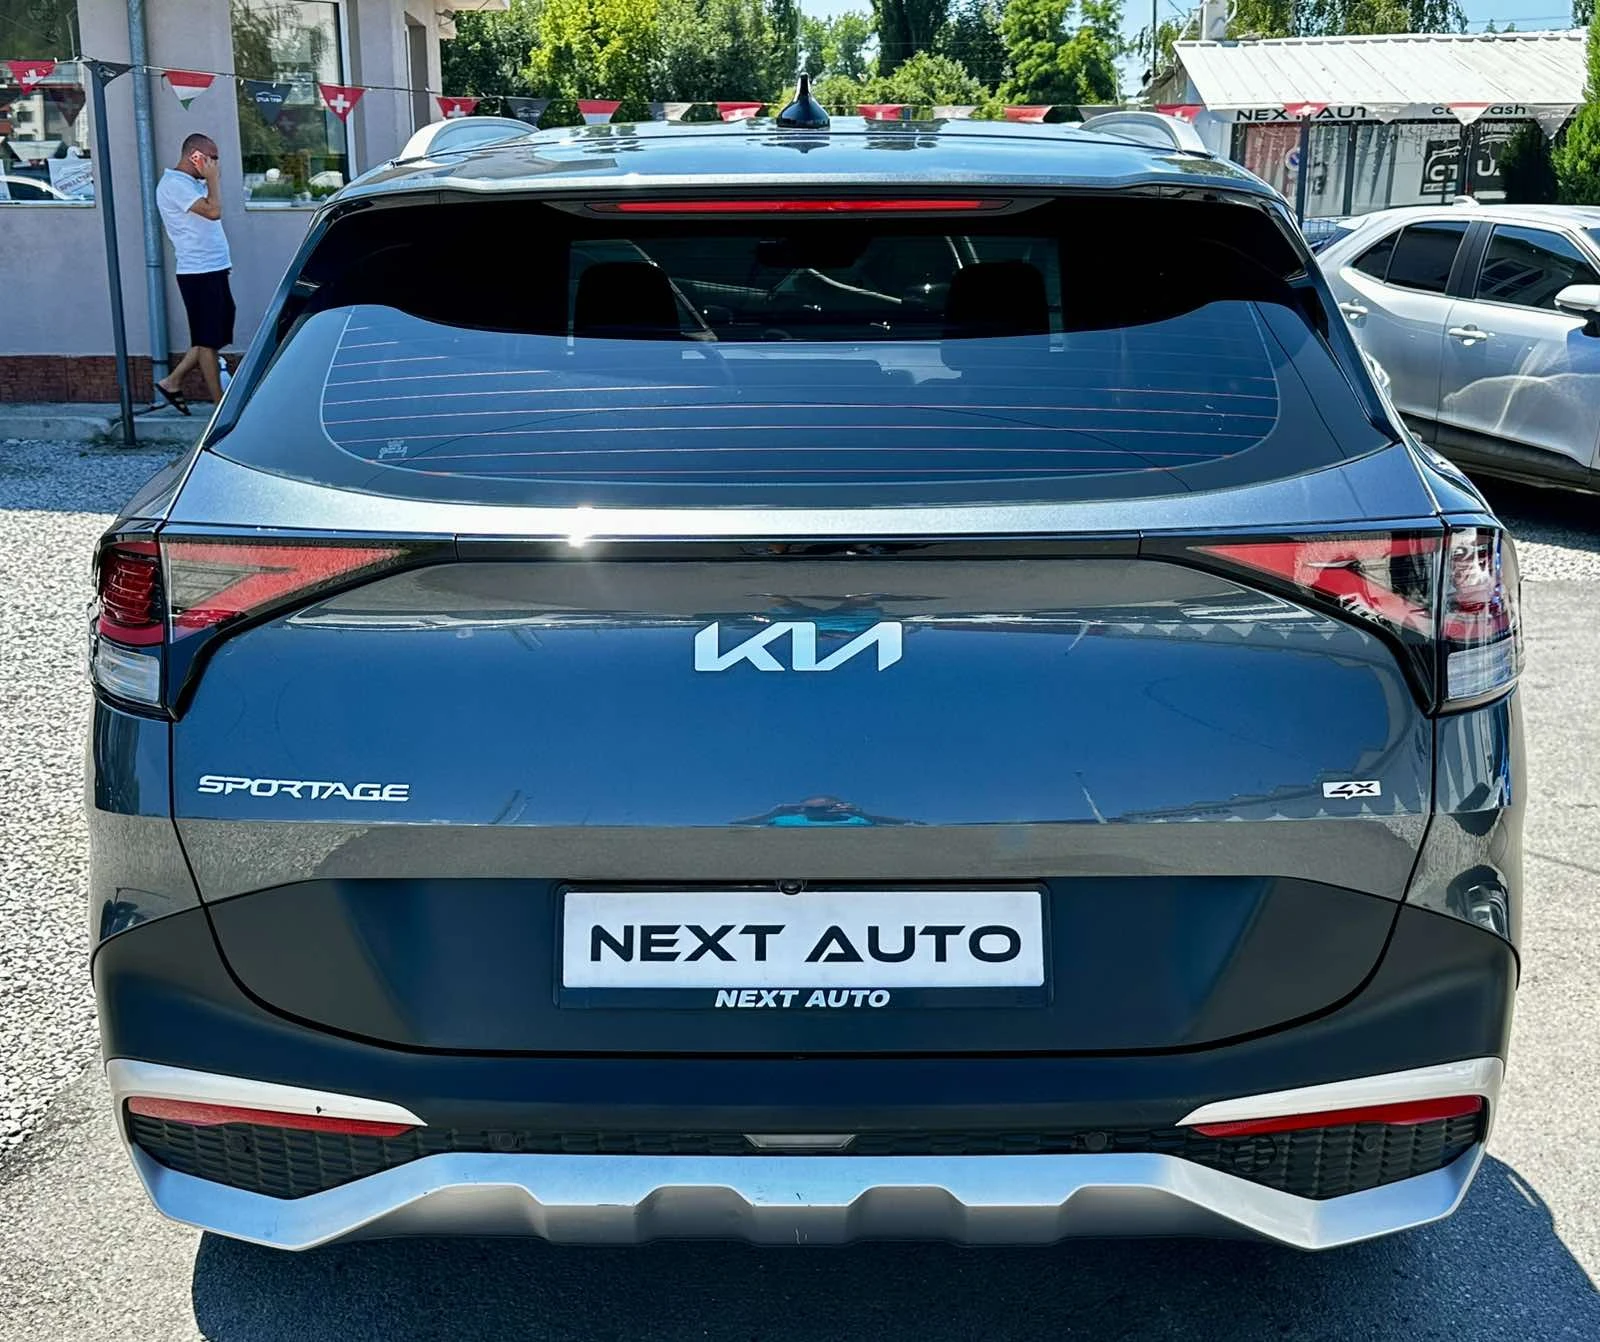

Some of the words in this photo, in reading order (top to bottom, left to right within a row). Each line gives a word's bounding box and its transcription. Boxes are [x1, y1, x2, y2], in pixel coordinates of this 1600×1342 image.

[1237, 109, 1301, 121] NEX
[694, 621, 903, 672] KIA
[198, 774, 410, 802] SPORTAGE
[590, 924, 786, 962] NEXT
[804, 924, 1022, 963] AUTO
[714, 989, 799, 1008] NEXT
[805, 989, 891, 1008] AUTO
